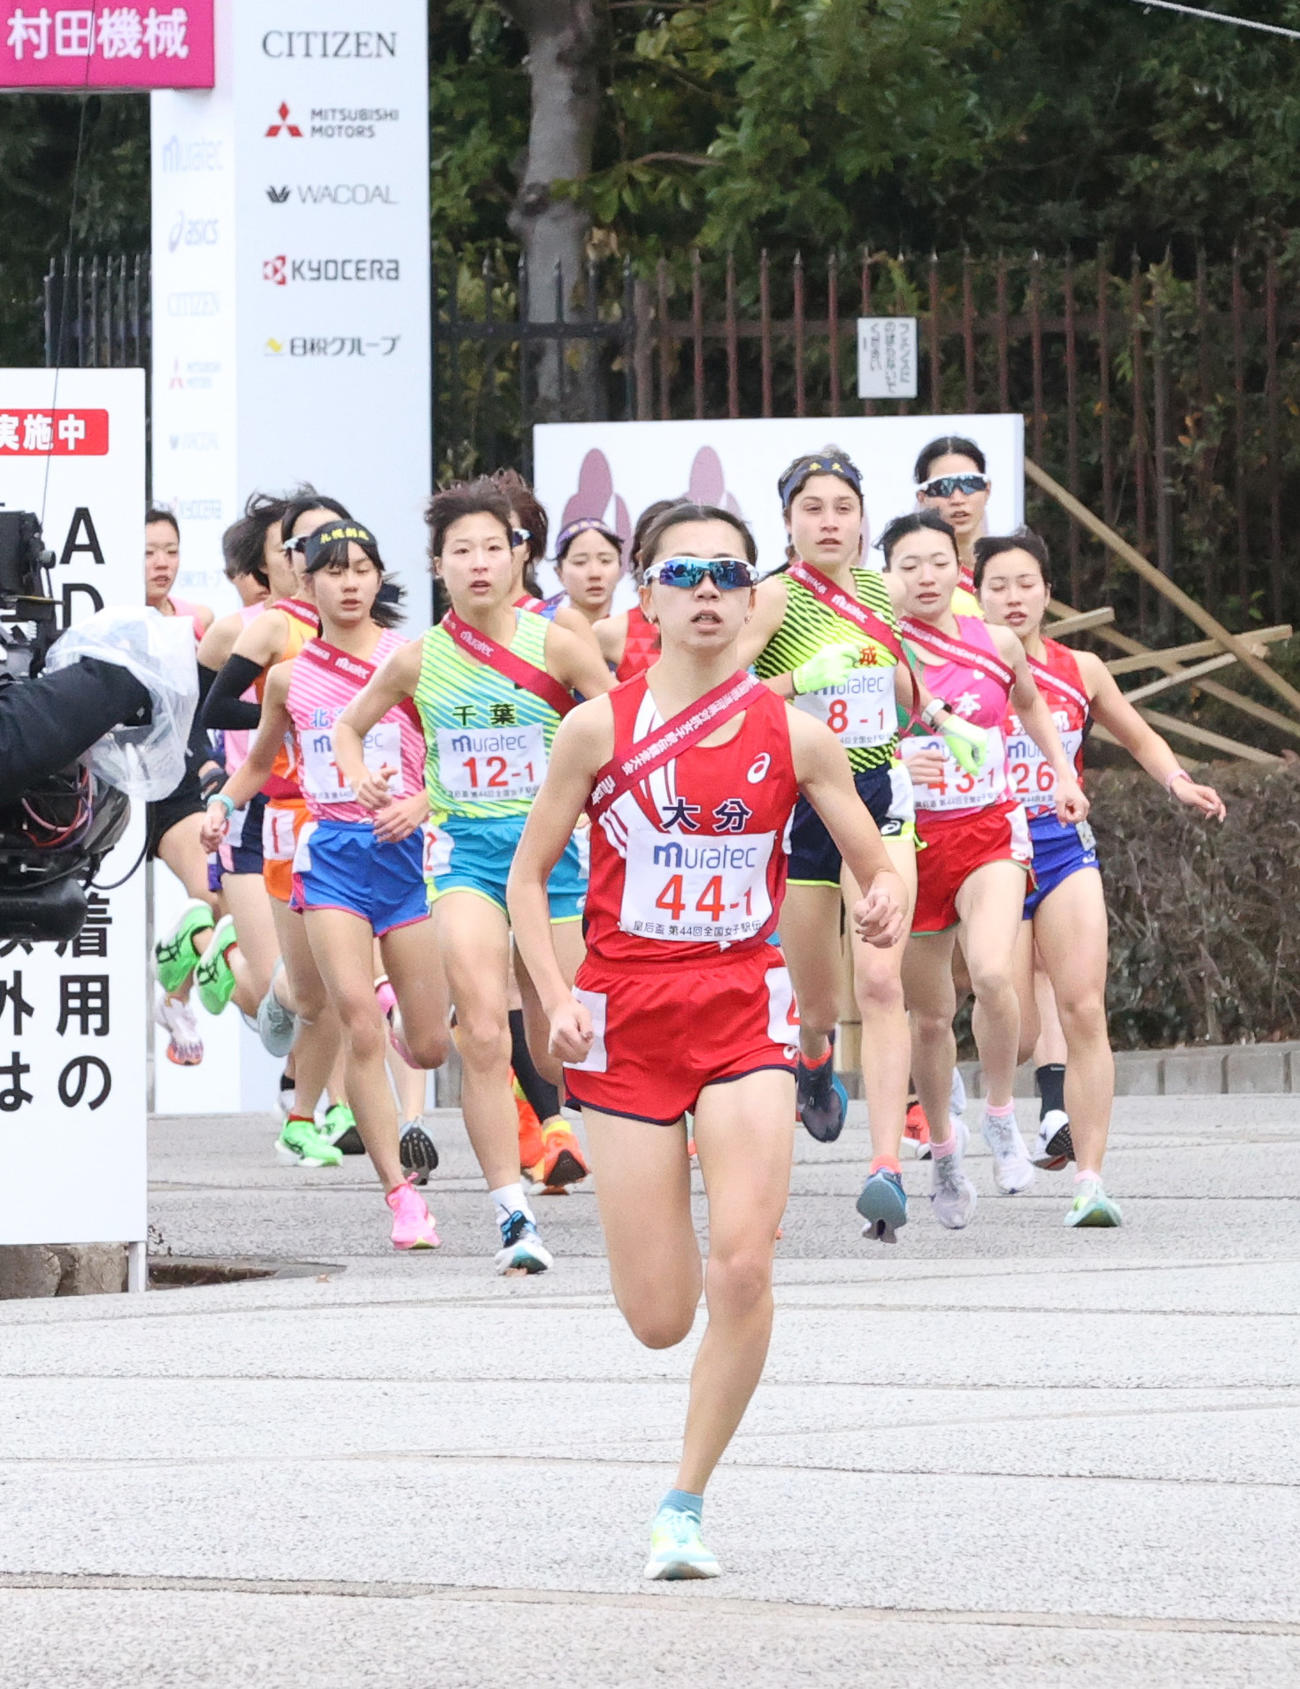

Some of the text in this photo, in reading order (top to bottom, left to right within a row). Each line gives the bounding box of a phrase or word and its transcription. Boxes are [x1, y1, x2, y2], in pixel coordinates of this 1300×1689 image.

[7, 7, 190, 60] 村田機械
[262, 30, 398, 58] CITIZEN
[310, 108, 400, 121] MITSUBISHI
[310, 125, 376, 138] MOTORS
[297, 184, 399, 205] WACOAL
[291, 258, 400, 281] KYOCERA
[452, 703, 515, 727] 千葉
[463, 756, 534, 788] 12-1
[661, 797, 752, 833] 大分
[656, 874, 753, 922] 44-1
